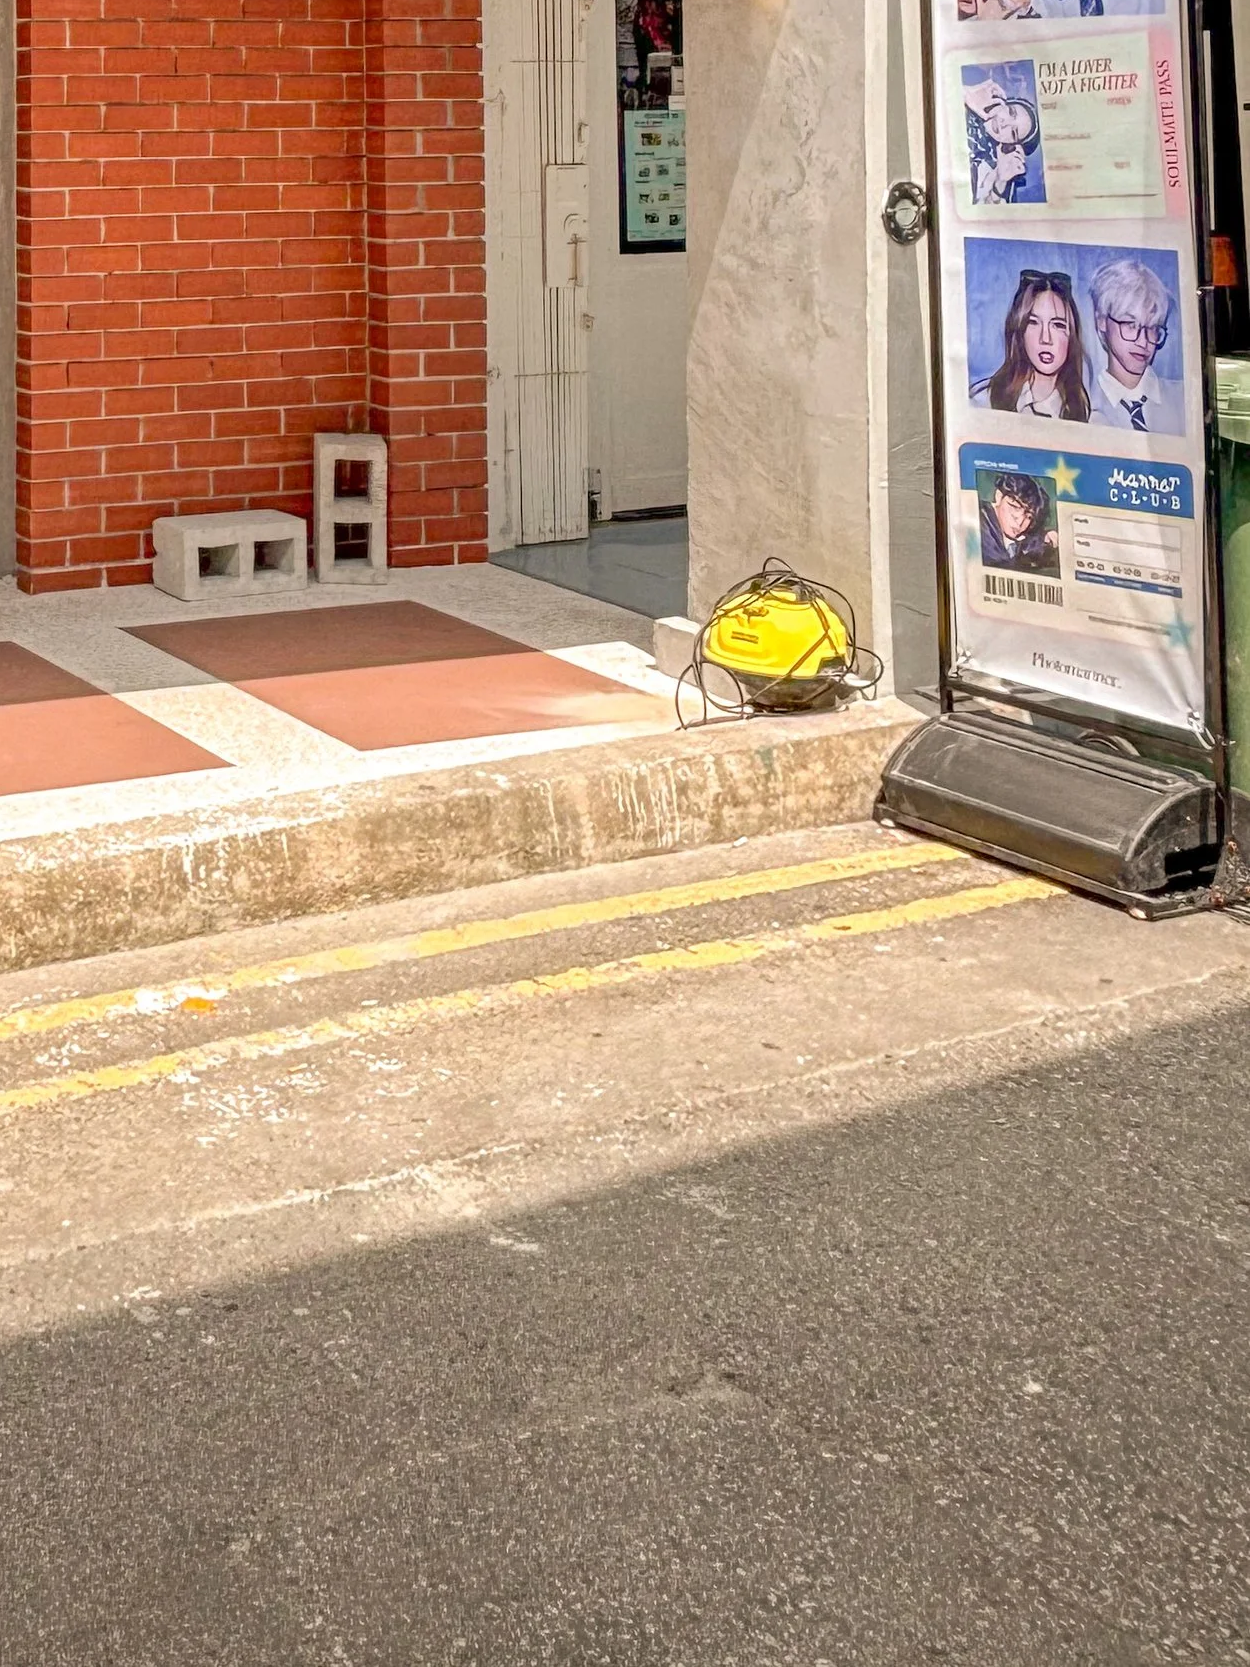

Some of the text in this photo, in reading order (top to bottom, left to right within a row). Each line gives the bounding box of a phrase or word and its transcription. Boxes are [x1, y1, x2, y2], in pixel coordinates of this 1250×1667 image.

[1071, 58, 1112, 76] LOVER
[1040, 79, 1066, 94] NOT
[1080, 73, 1139, 93] FIGHTER
[1156, 60, 1181, 188] SOULMATE PASS
[1108, 468, 1180, 493] Manner
